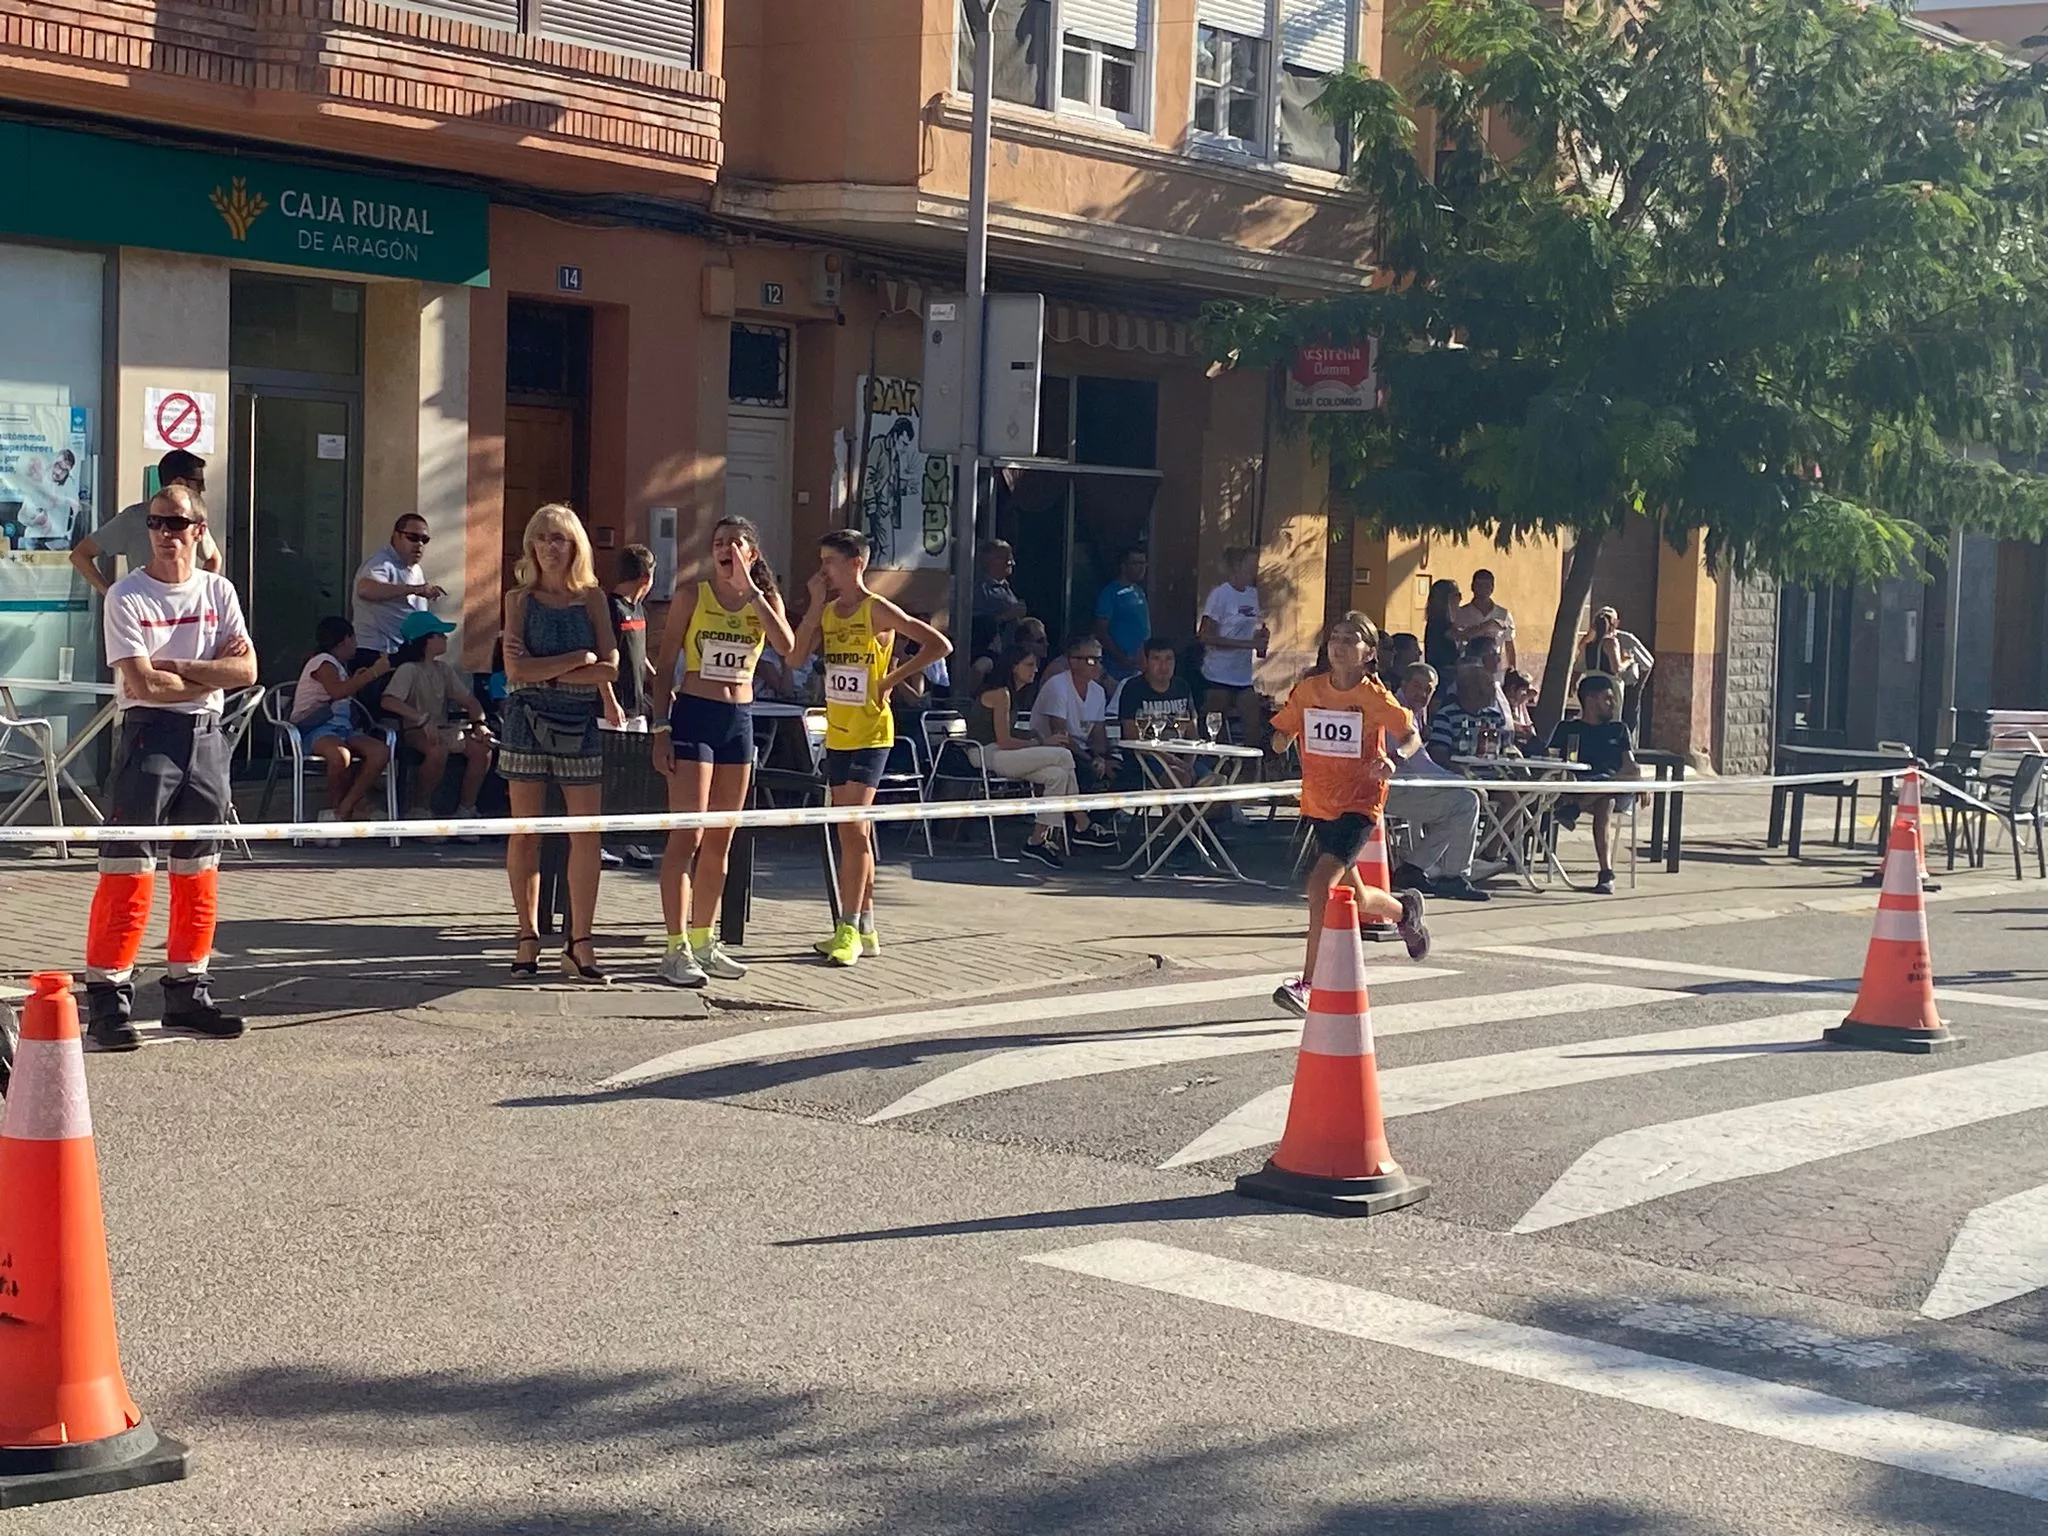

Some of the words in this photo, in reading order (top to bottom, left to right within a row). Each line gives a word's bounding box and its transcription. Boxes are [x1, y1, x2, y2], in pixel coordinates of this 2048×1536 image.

[280, 190, 345, 224] CAJA
[353, 200, 434, 235] RURAL
[298, 229, 325, 251] DE
[564, 269, 579, 289] 14
[767, 285, 781, 304] 12
[1314, 361, 1350, 376] Damm
[0, 432, 46, 441] utónomos
[713, 651, 748, 670] 101
[831, 674, 859, 692] 103
[1314, 722, 1352, 741] 109
